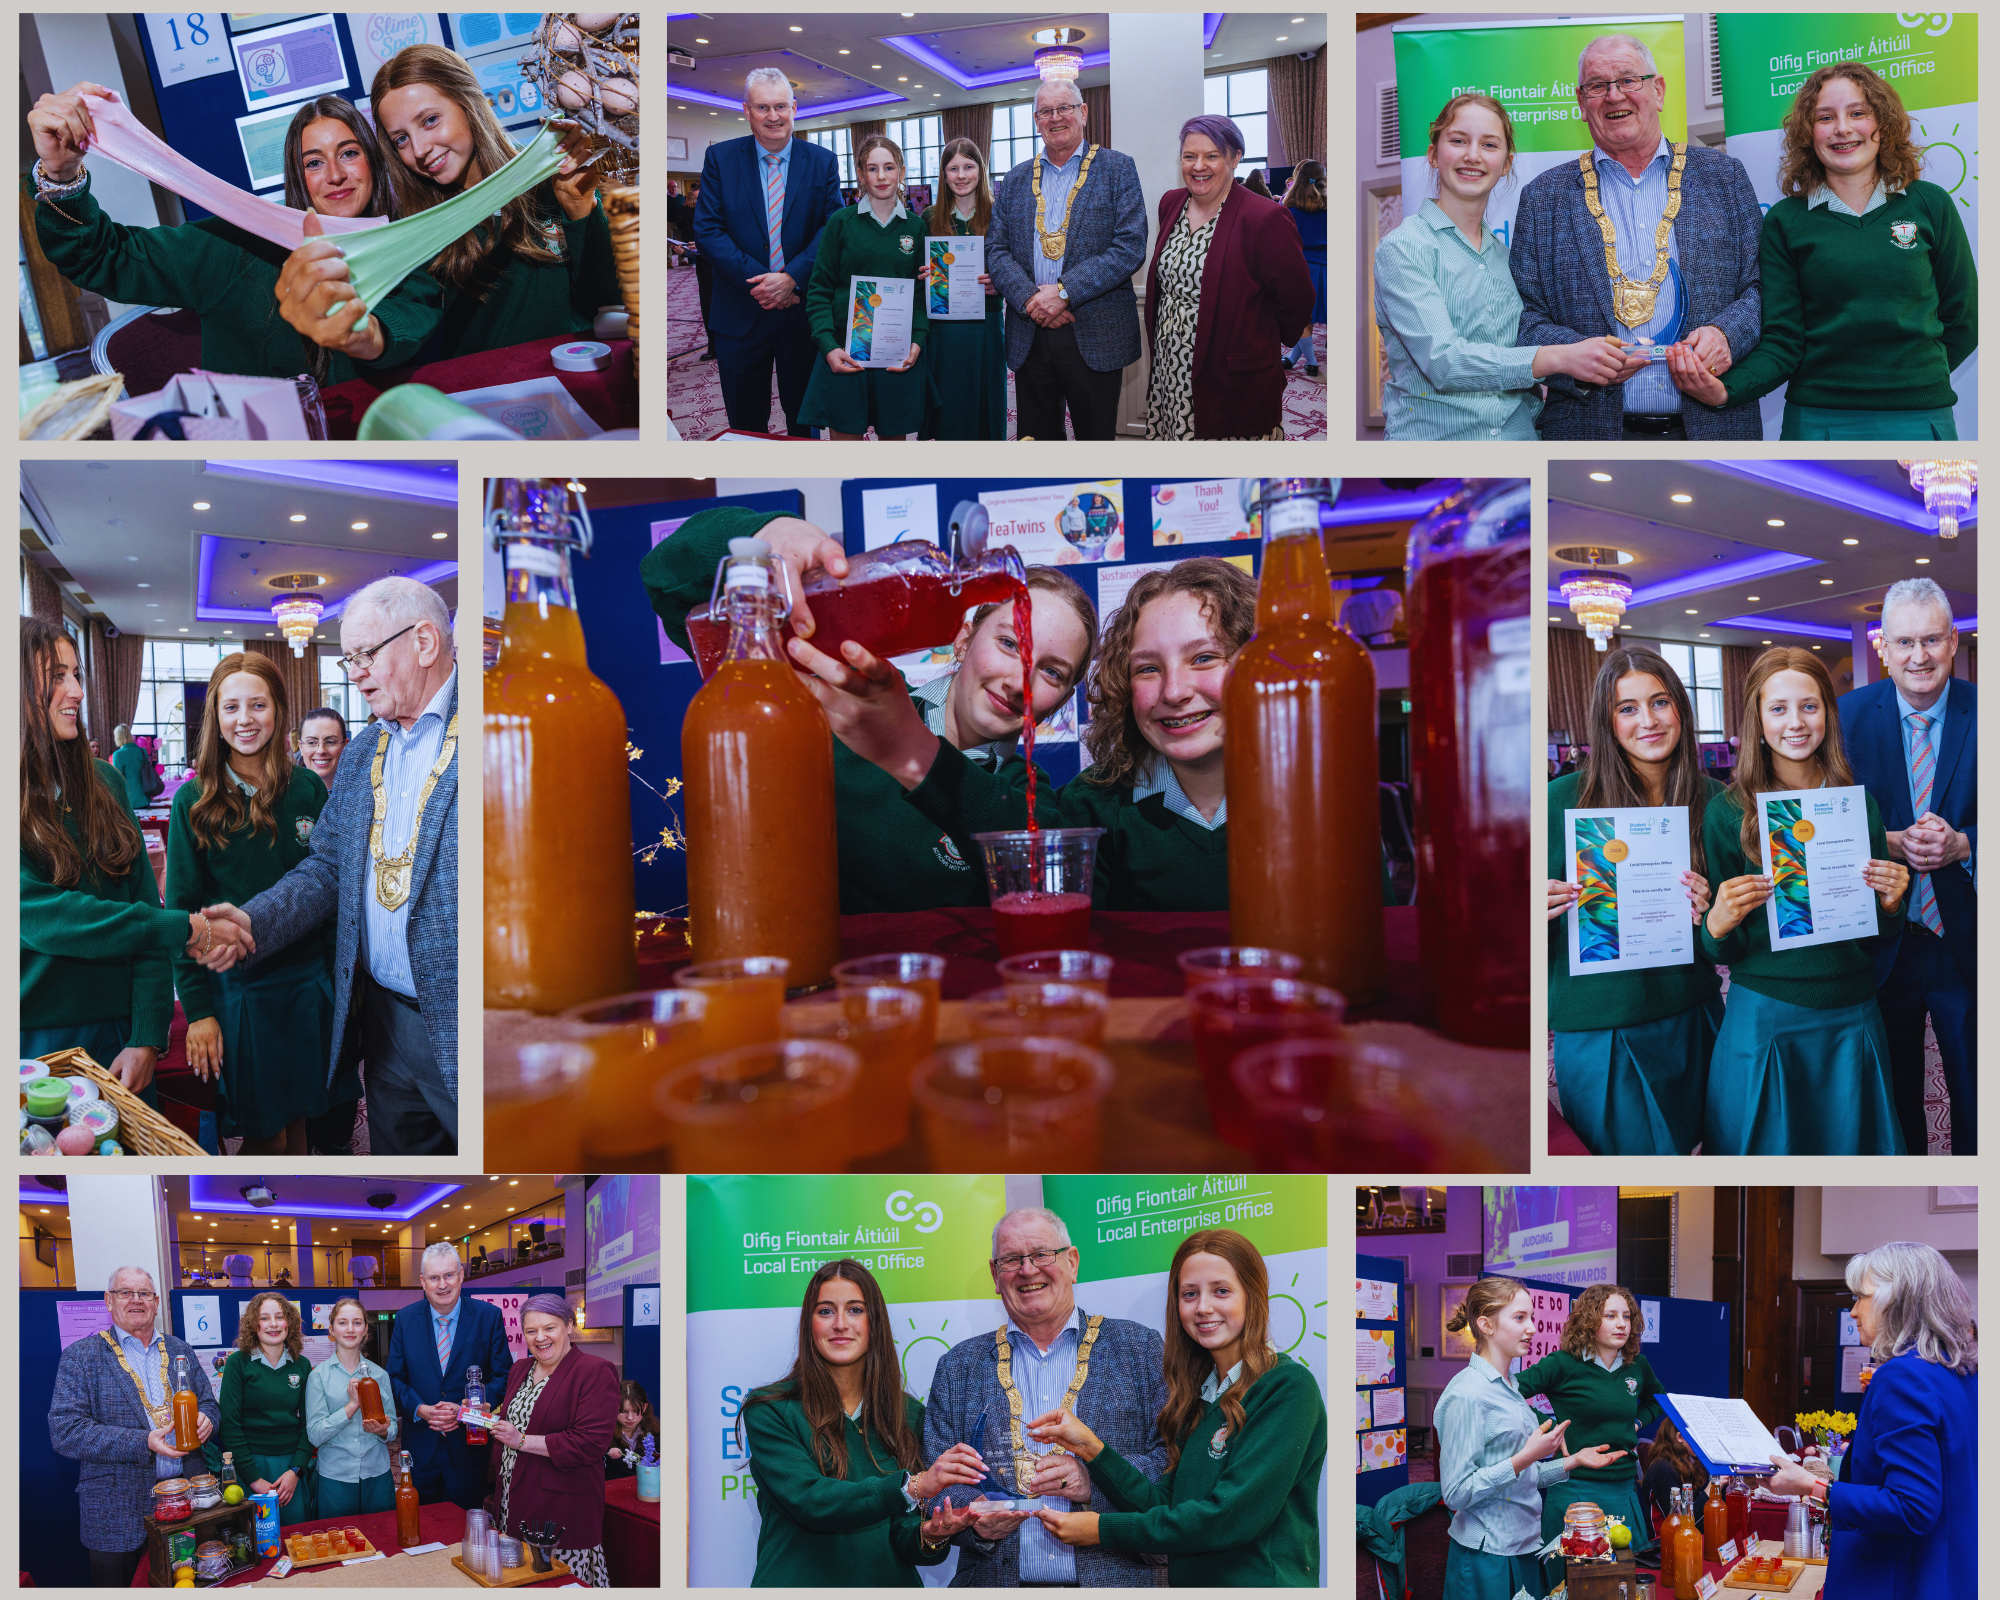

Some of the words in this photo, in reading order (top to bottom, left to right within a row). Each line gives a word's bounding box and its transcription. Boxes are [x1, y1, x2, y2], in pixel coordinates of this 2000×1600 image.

[166, 13, 209, 51] 18
[371, 15, 420, 41] Slime
[380, 29, 420, 57] Spot
[1769, 54, 1803, 73] Oifig
[1806, 43, 1864, 66] Fiontair
[1867, 33, 1910, 56] Áitiúil
[1889, 59, 1935, 79] Office
[1490, 84, 1548, 99] Fiontair
[1506, 107, 1568, 125] nterprise
[504, 410, 540, 422] Slime
[512, 417, 542, 428] Spot
[1194, 484, 1223, 497] Thank
[1198, 498, 1220, 512] You!
[989, 519, 1046, 537] TeaTwins
[908, 678, 927, 686] Survey
[1096, 1195, 1131, 1216] Oifig
[1136, 1183, 1198, 1208] Fiontair
[1202, 1174, 1247, 1197] Áitiúil
[1097, 1221, 1137, 1244] Local
[1141, 1210, 1221, 1236] Enterprise
[1225, 1201, 1273, 1222] Office
[743, 1232, 781, 1251] Oifig
[786, 1229, 850, 1247] Fiontair
[854, 1225, 900, 1244] Áitiúil
[1522, 1232, 1553, 1247] JUDGING
[605, 1246, 615, 1260] STAGE
[615, 1242, 625, 1255] TIME
[744, 1258, 786, 1275] Local
[877, 1253, 925, 1270] Office
[587, 1285, 604, 1299] STUDENT
[631, 1267, 658, 1285] AWARDS
[1567, 1266, 1607, 1284] AWARDS
[502, 1297, 519, 1309] DO
[643, 1302, 651, 1315] 8
[1549, 1297, 1562, 1311] DO
[197, 1315, 208, 1331] 6
[1648, 1317, 1654, 1331] 8
[1847, 1324, 1854, 1336] 9
